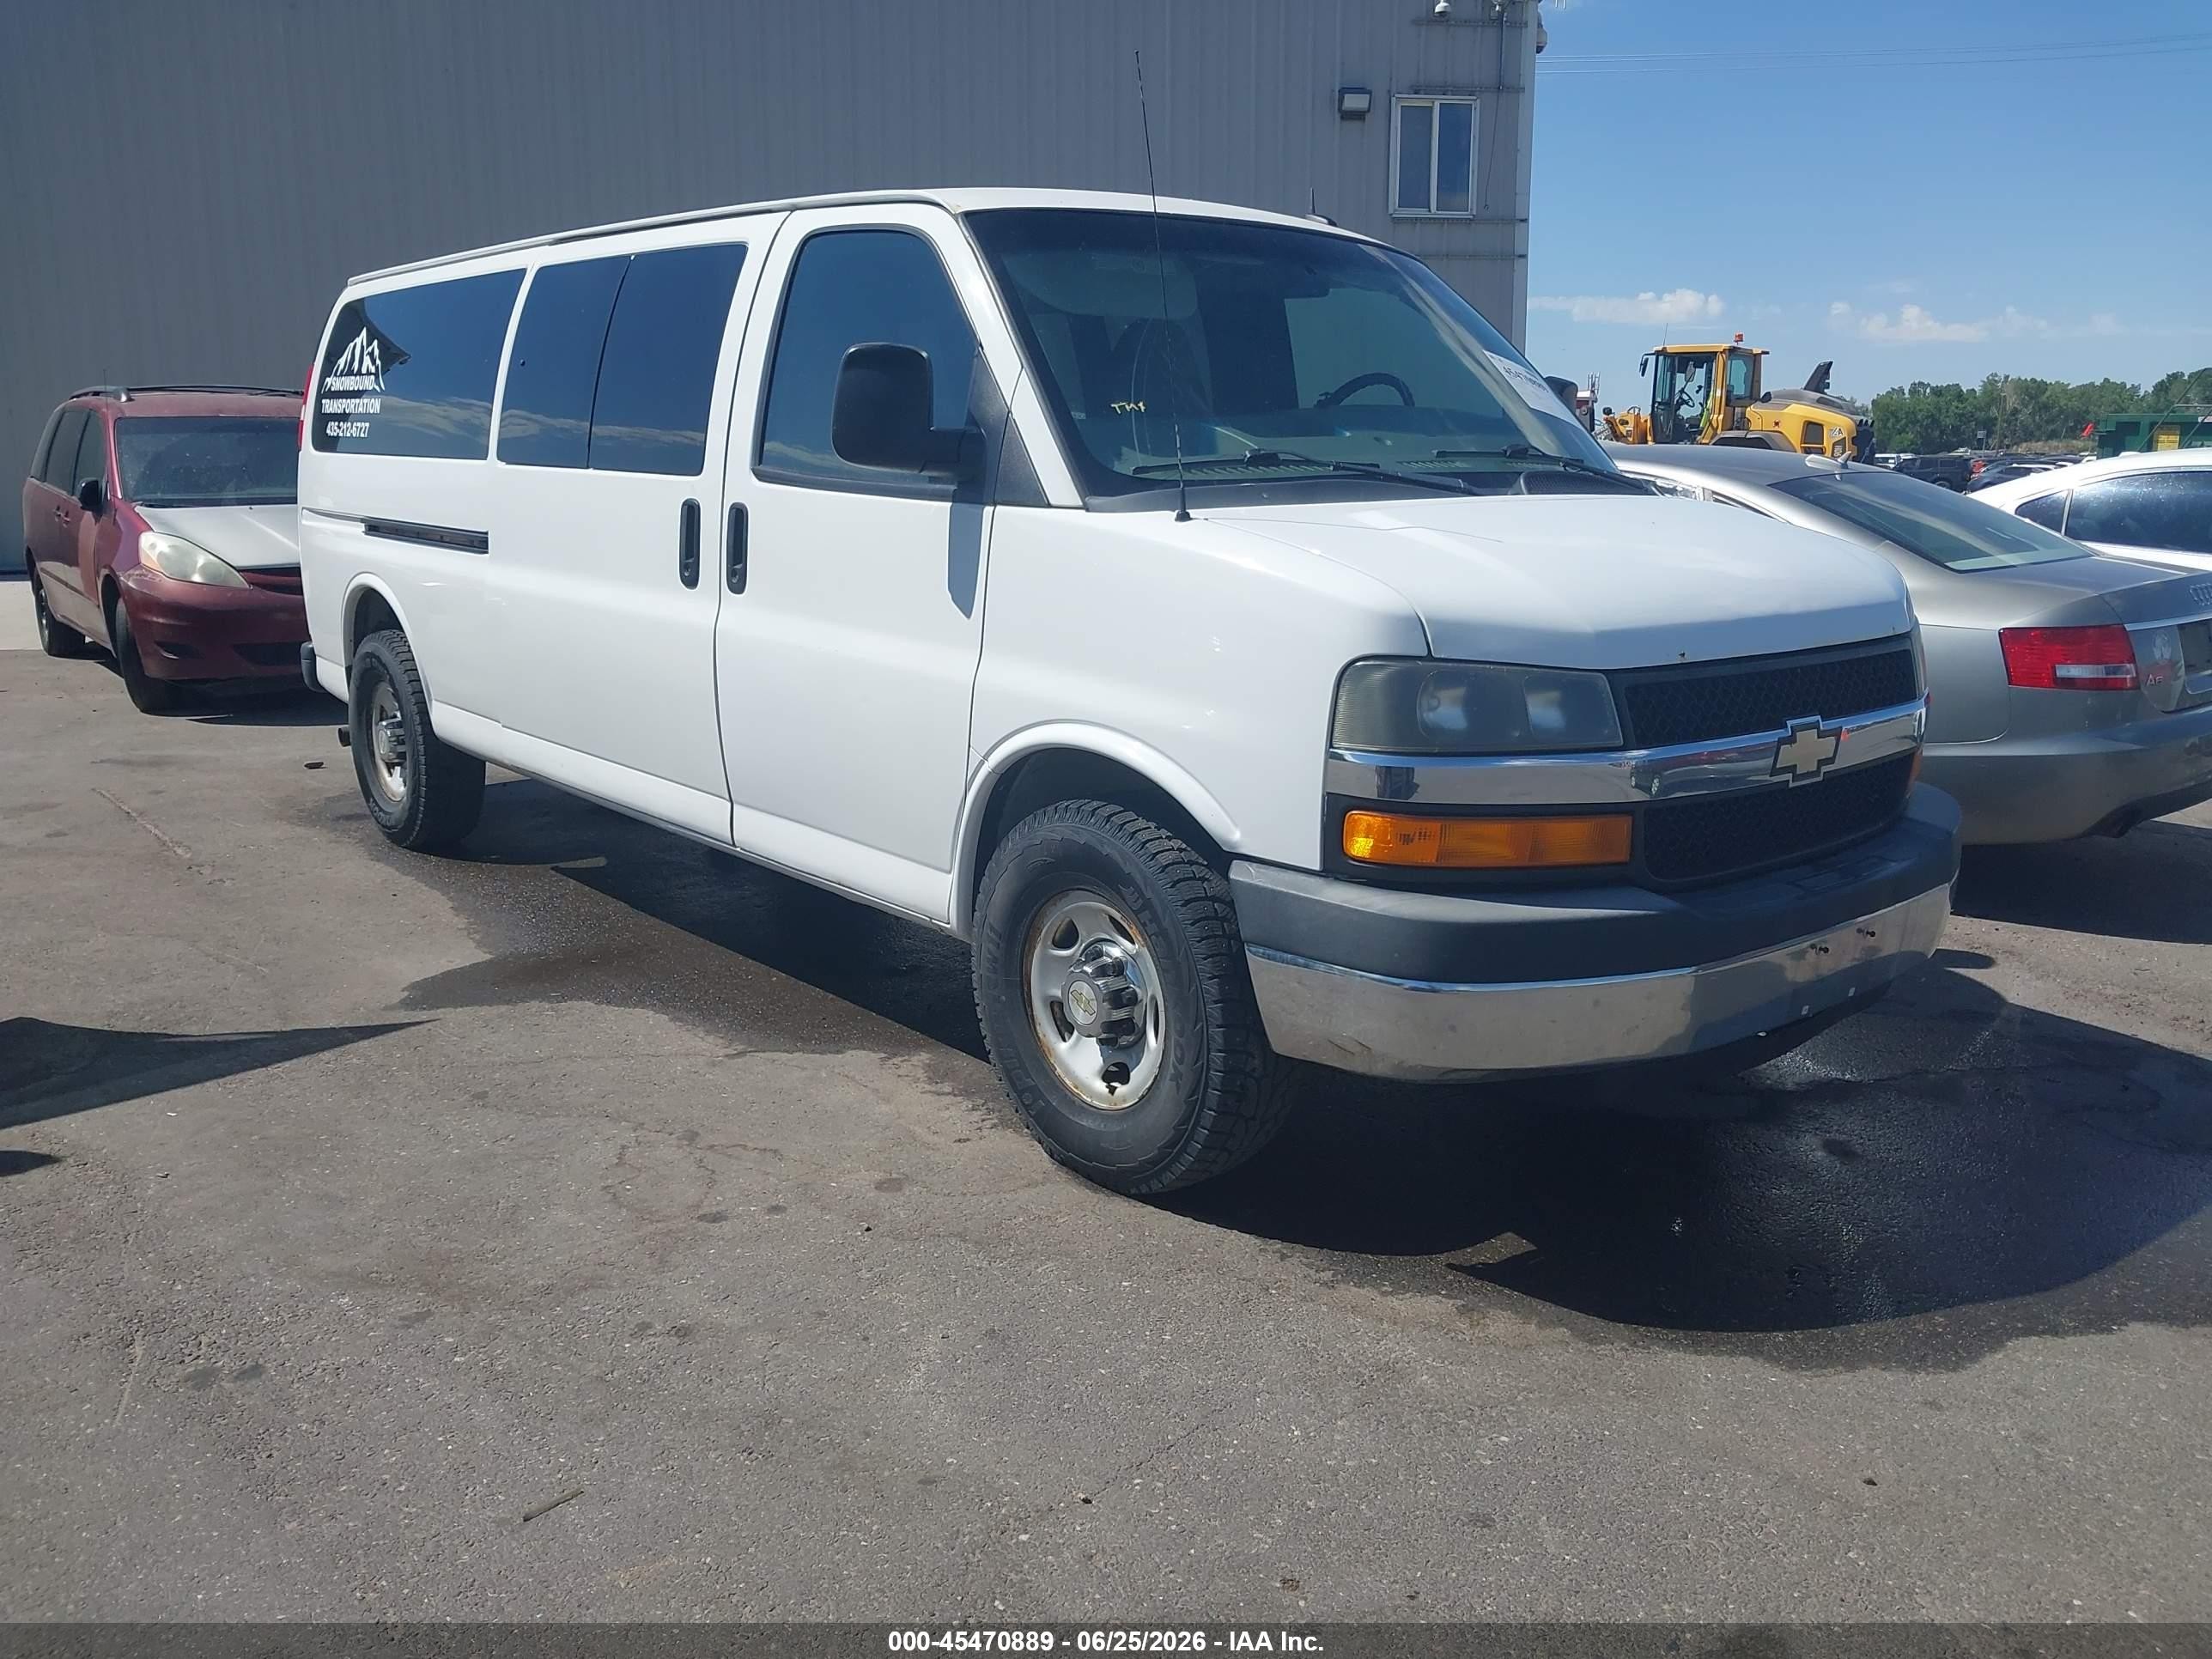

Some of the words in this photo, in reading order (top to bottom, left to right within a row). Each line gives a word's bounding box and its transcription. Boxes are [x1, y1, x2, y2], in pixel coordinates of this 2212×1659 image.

[331, 375, 374, 391] SNOWBOUND
[321, 398, 380, 414] TRANSPORTATION
[326, 422, 369, 437] 435-212-6727
